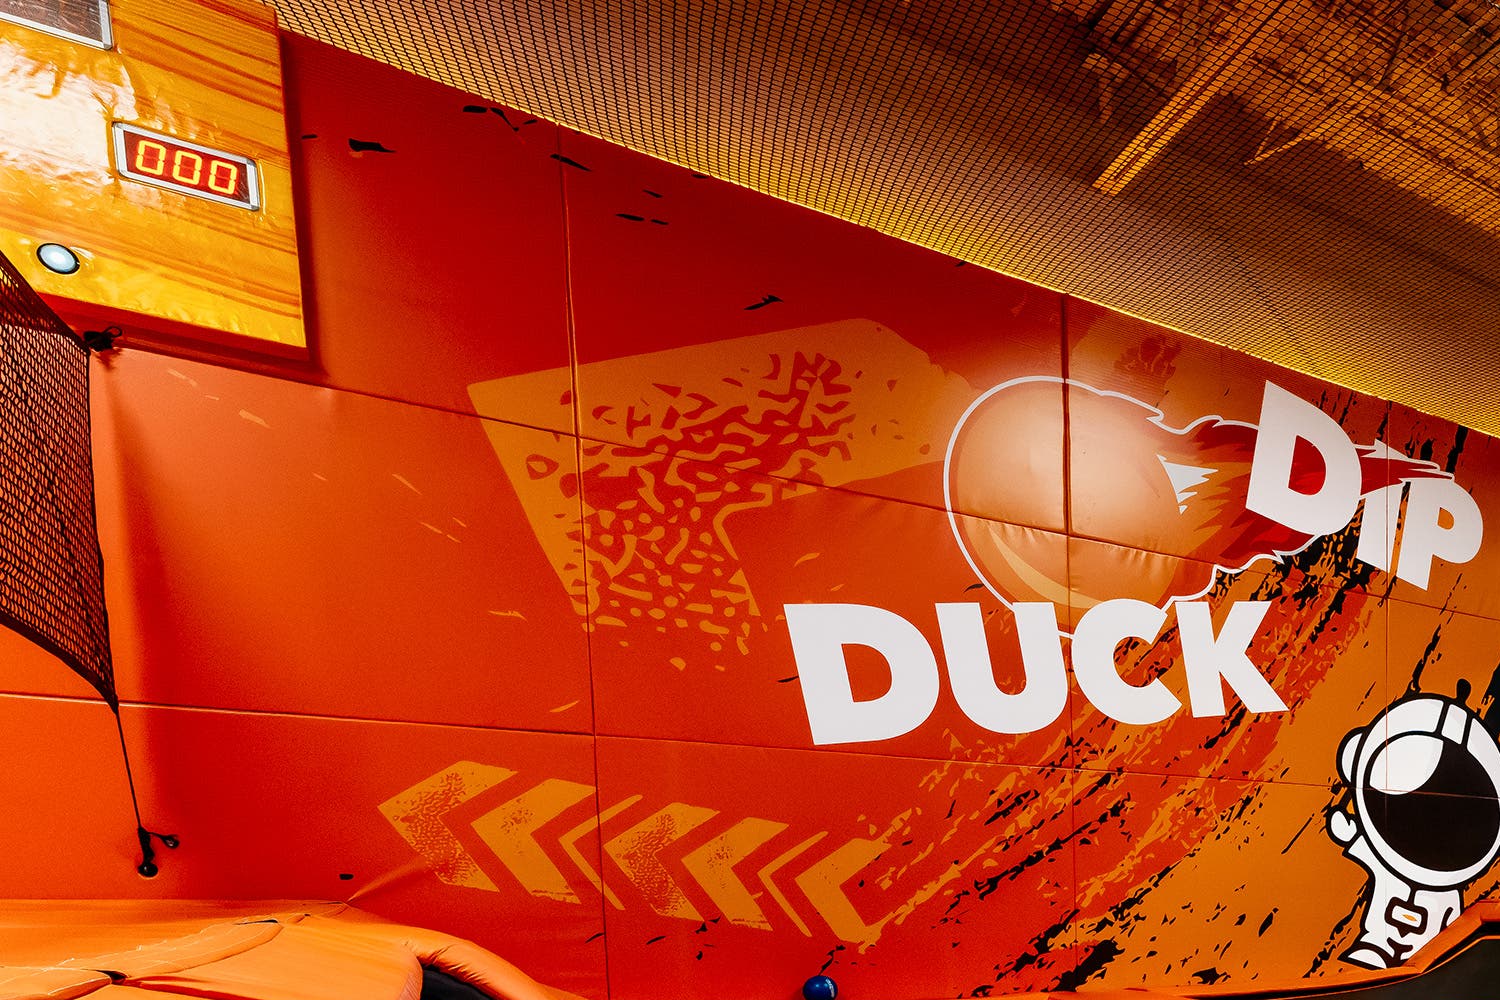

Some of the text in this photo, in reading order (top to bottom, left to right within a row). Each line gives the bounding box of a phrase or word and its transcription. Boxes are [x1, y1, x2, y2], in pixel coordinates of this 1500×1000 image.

[135, 140, 238, 195] 000
[1245, 380, 1484, 592] DIP
[783, 598, 1290, 746] DUCK
